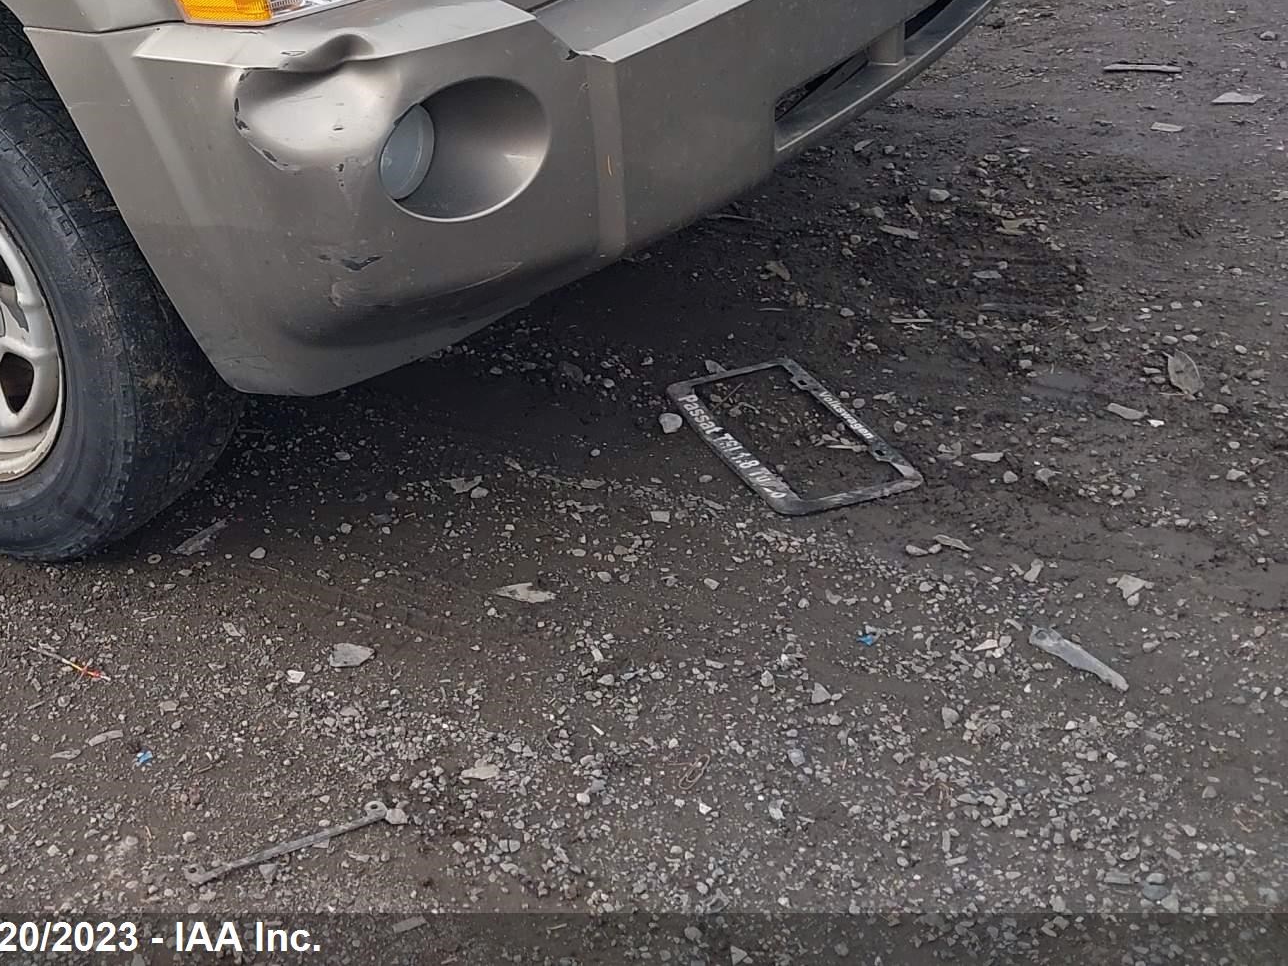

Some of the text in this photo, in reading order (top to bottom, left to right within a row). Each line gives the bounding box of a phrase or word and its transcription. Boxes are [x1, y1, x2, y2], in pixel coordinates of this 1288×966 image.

[677, 394, 724, 434] Passat
[748, 467, 787, 498] Tuo
[819, 391, 874, 439] Volkswagen
